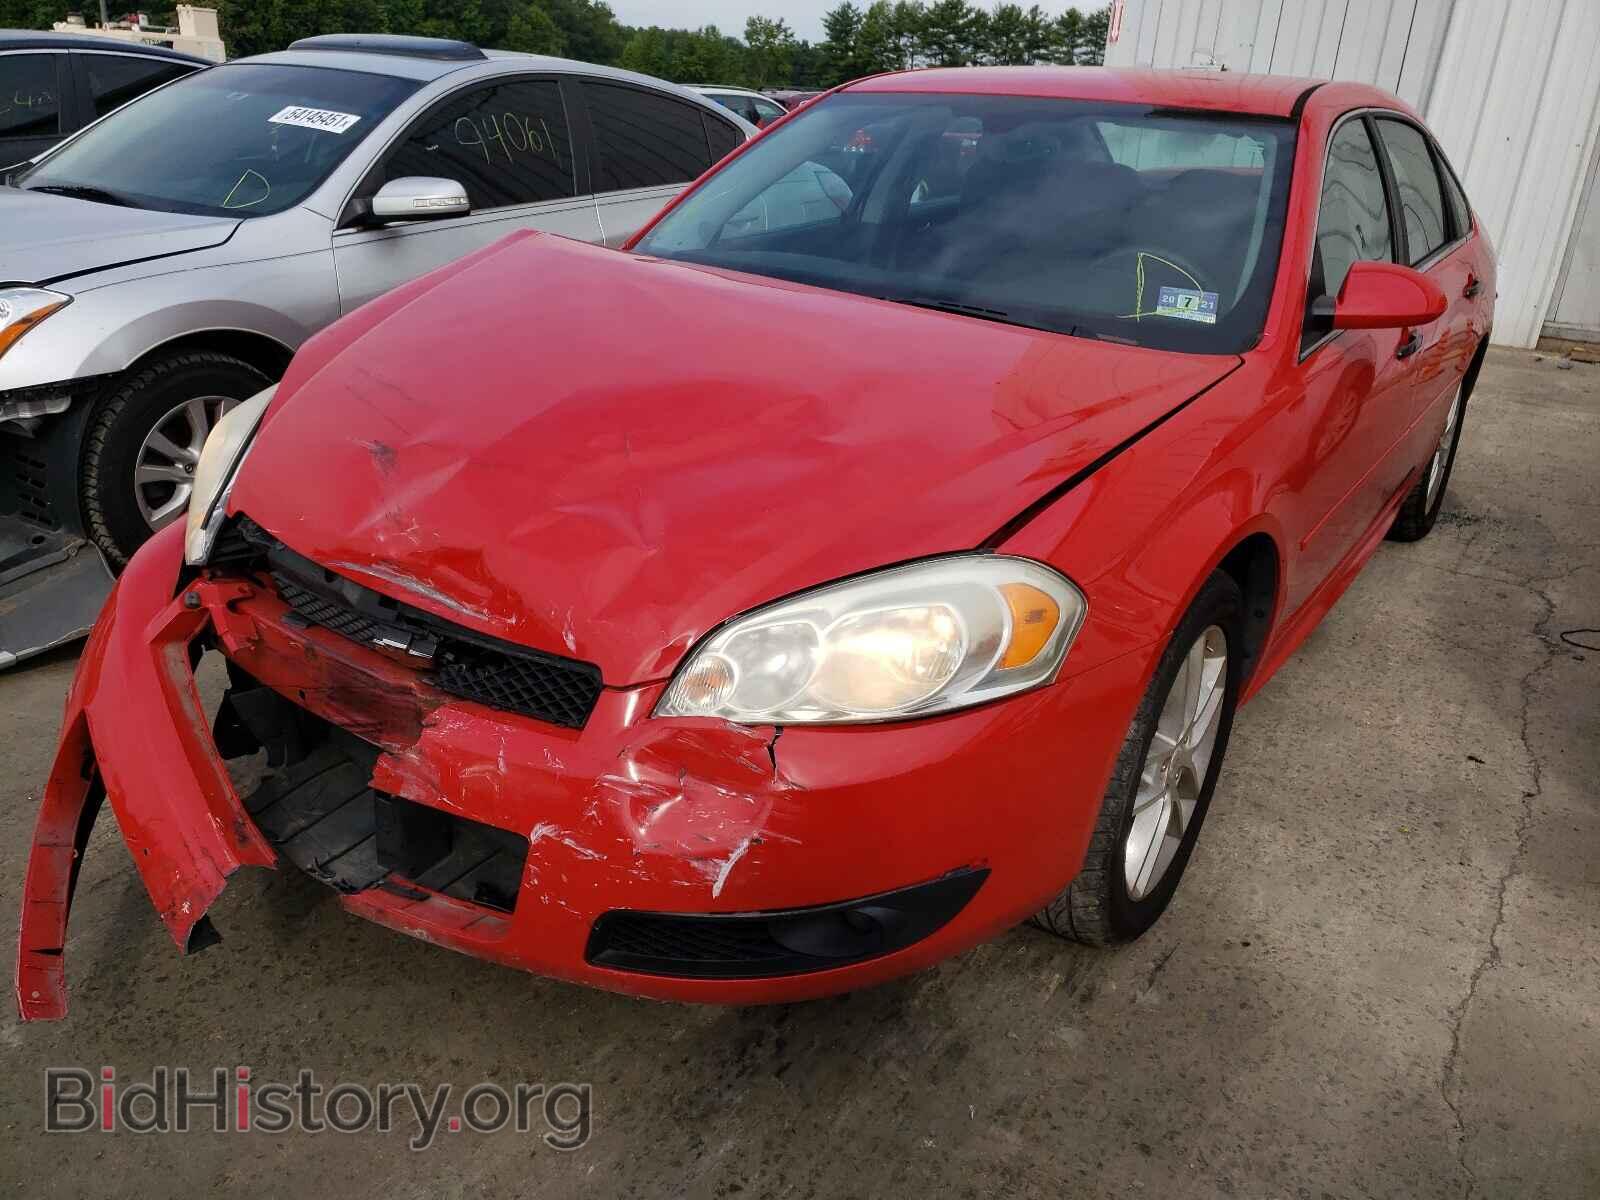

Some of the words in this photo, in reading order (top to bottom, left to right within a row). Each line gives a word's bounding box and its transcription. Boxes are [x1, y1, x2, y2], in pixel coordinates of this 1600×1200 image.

[454, 112, 557, 165] 94061
[1161, 295, 1175, 304] 20
[1200, 299, 1214, 309] 21
